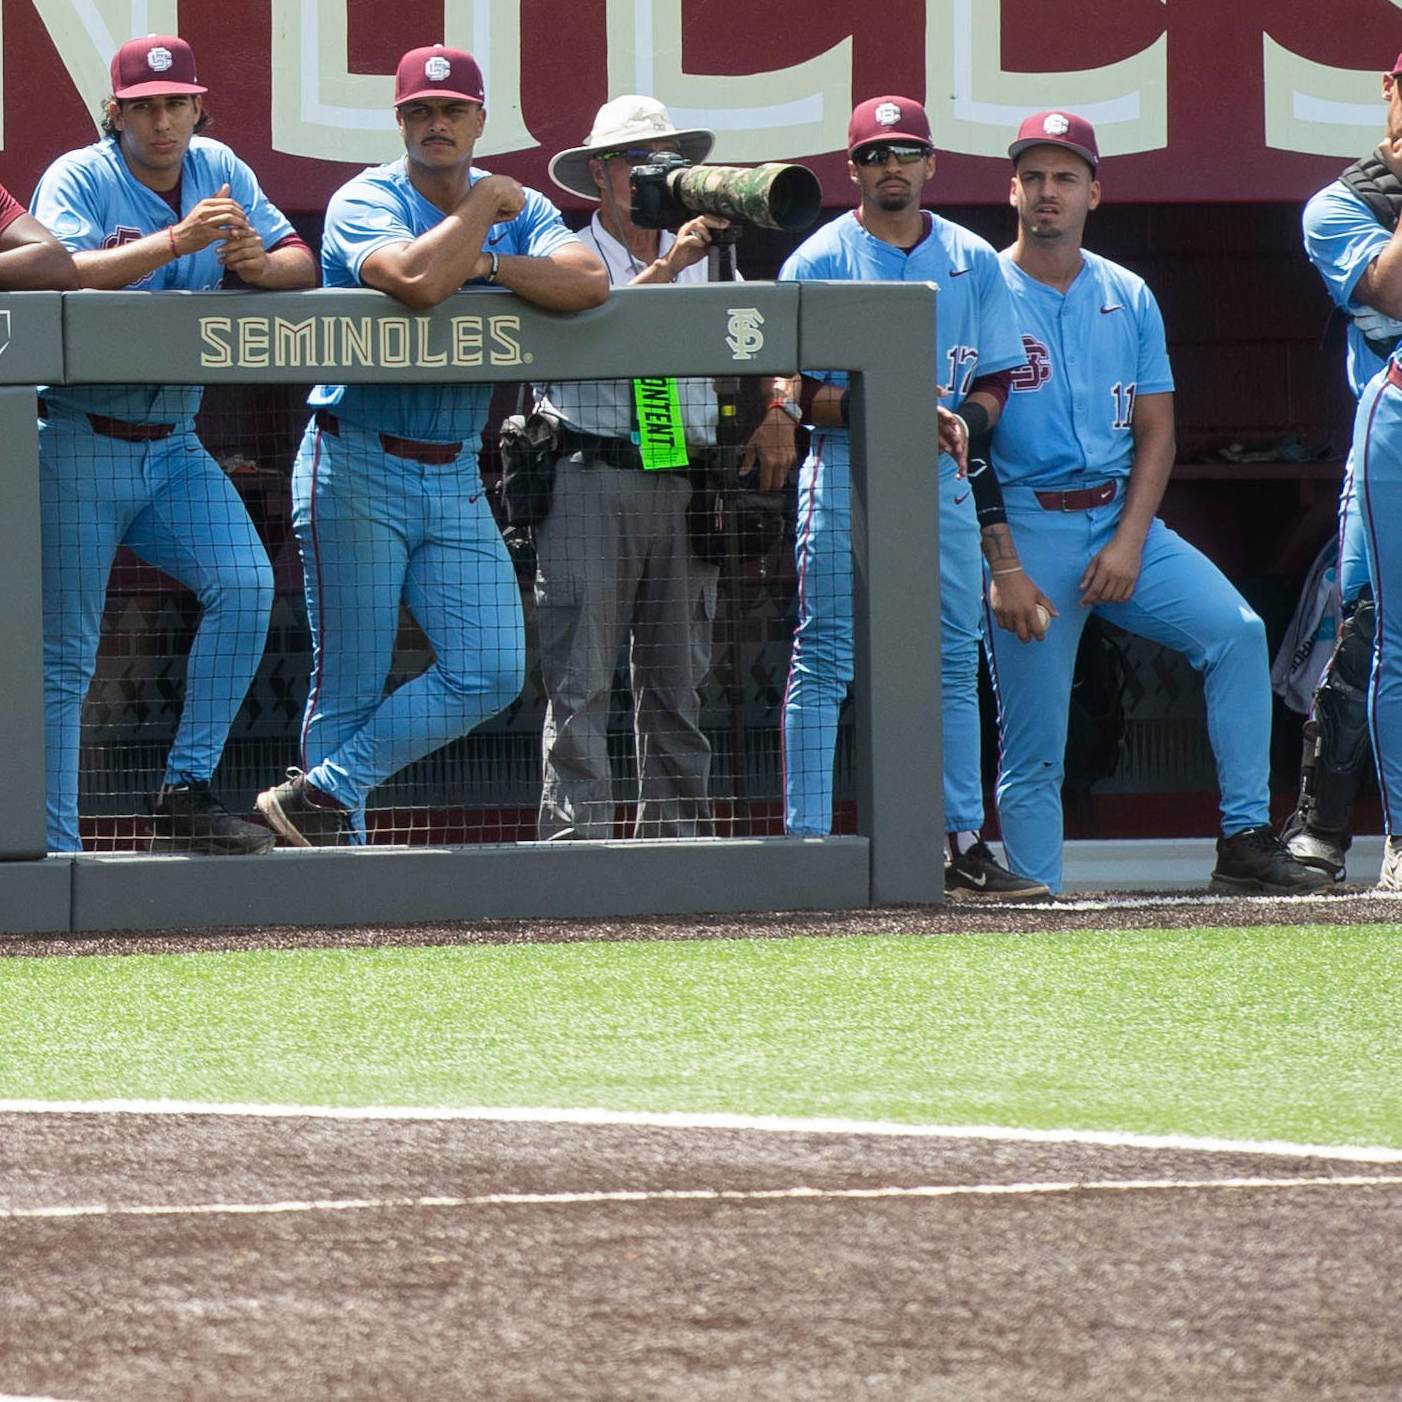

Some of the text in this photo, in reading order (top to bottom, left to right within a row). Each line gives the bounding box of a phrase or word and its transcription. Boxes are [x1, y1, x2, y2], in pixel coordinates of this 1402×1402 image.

[199, 315, 522, 368] SEMINOLES
[946, 345, 979, 396] 17
[640, 378, 676, 448] ONTENT
[1109, 381, 1138, 430] 11
